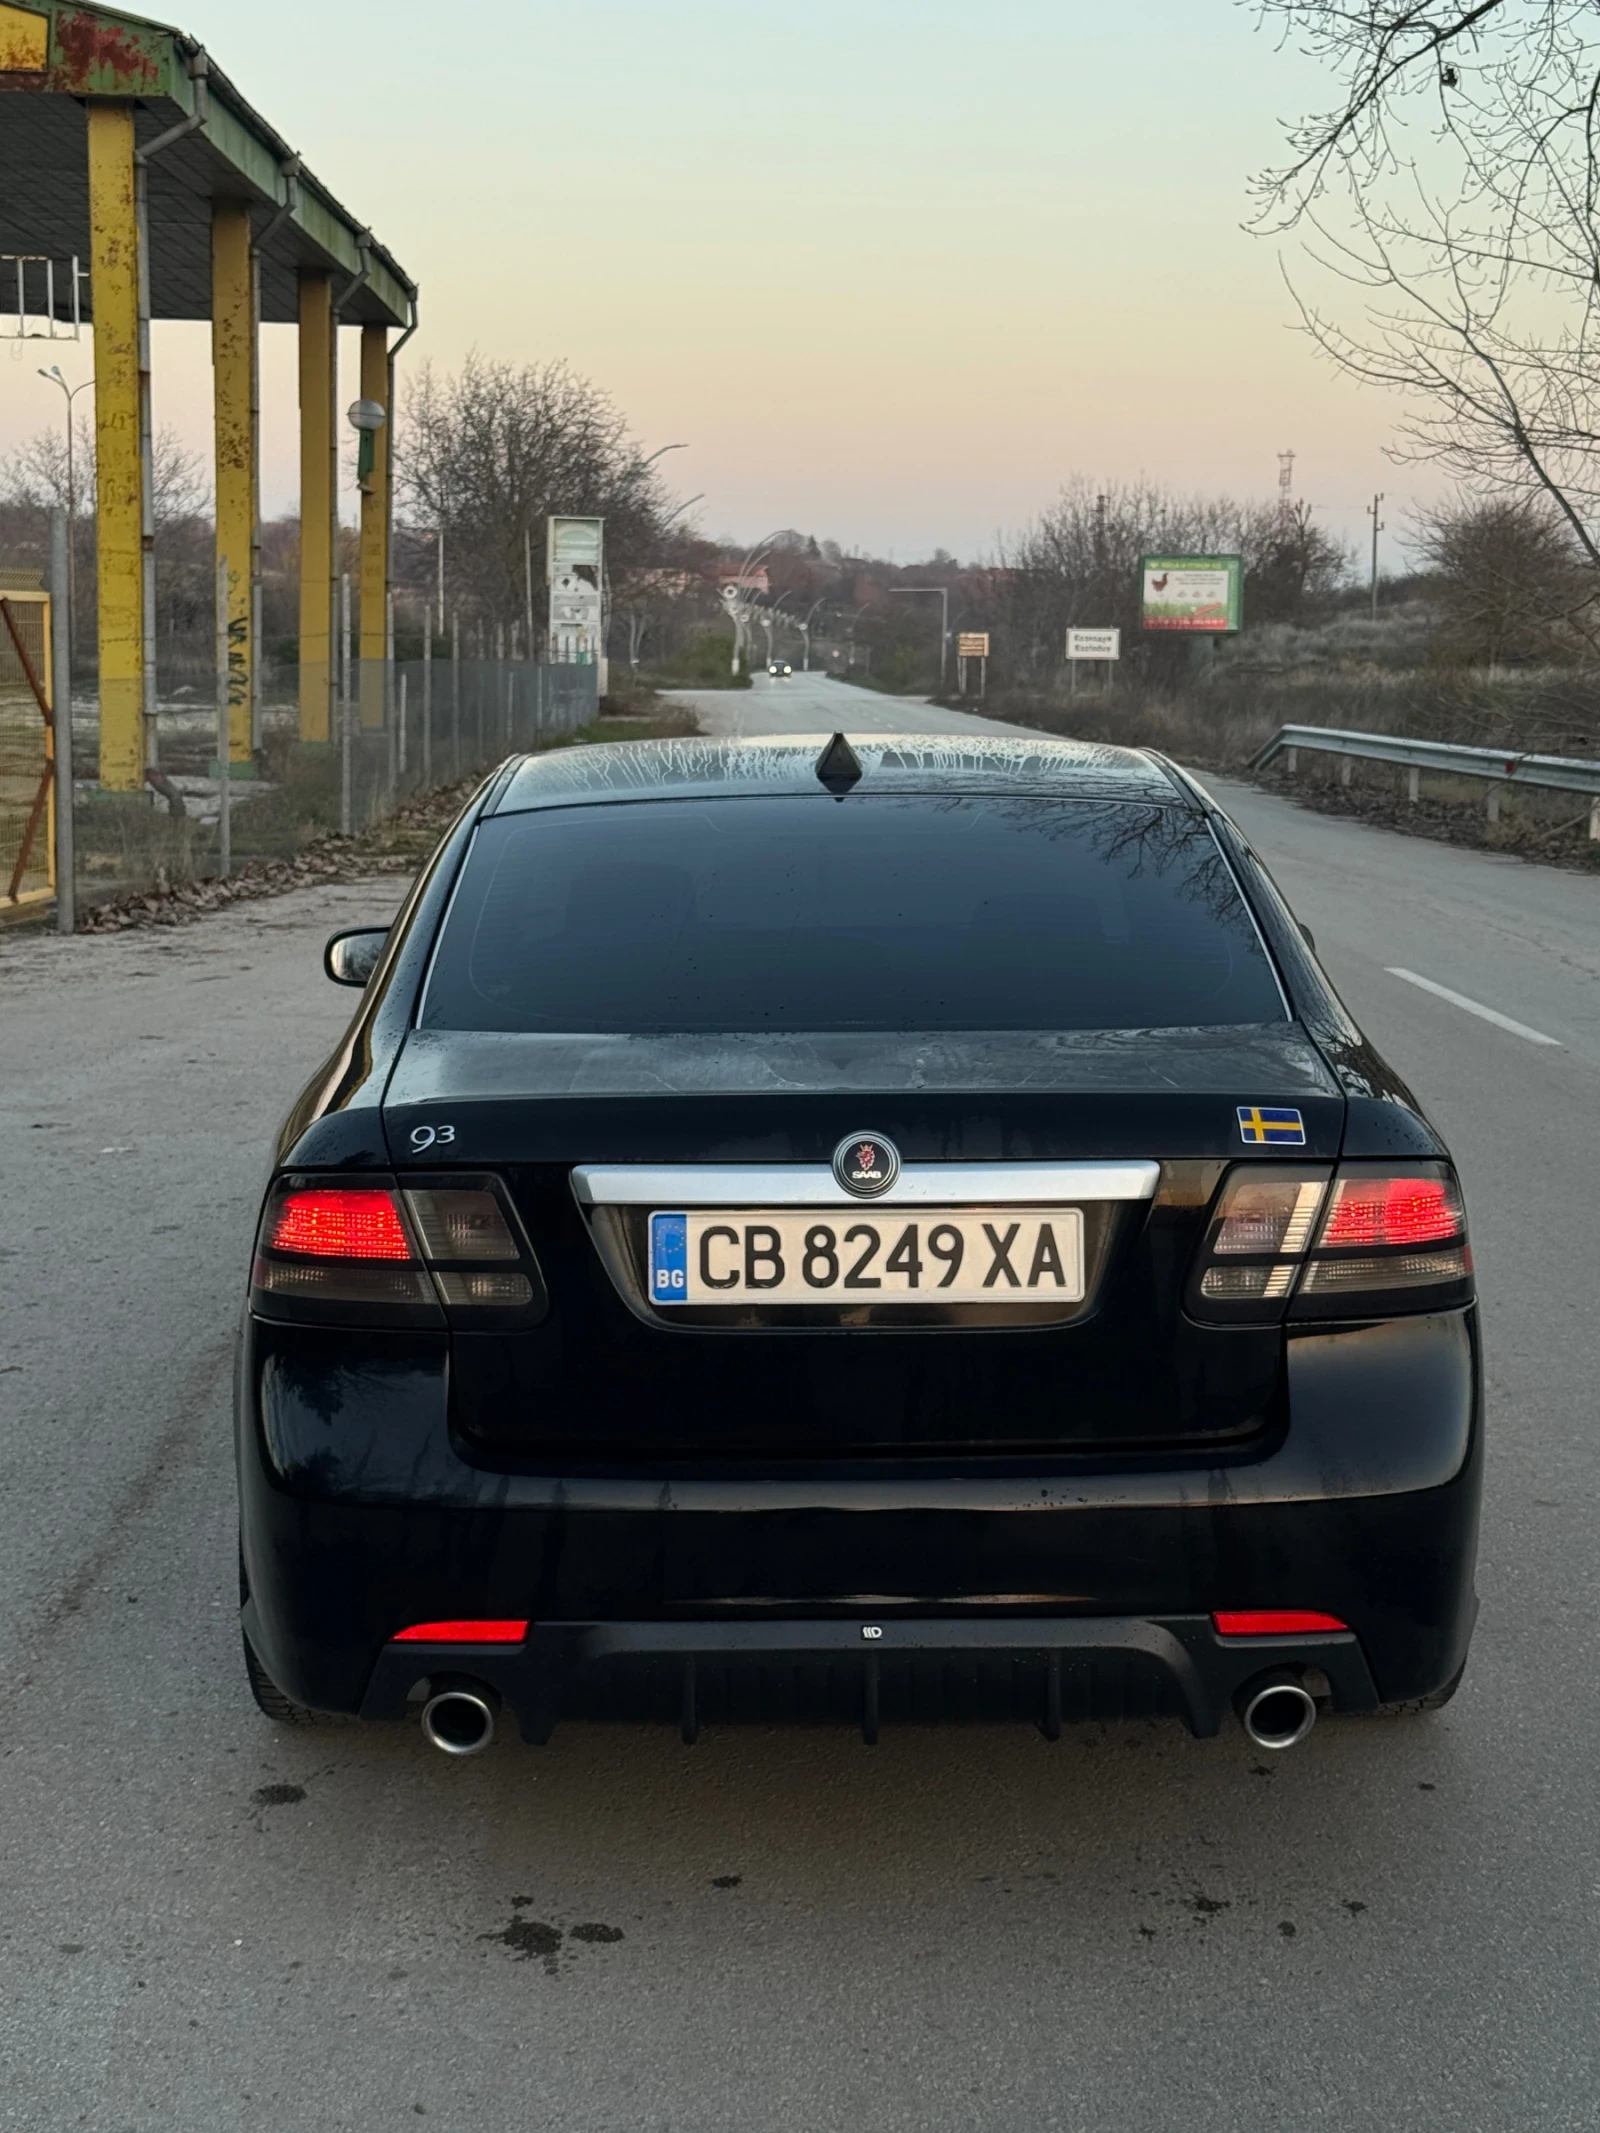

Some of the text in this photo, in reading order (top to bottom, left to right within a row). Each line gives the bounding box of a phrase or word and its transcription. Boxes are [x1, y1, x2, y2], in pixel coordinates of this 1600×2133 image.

[410, 1125, 456, 1153] 93
[852, 1170, 882, 1179] SAAB
[699, 1222, 1067, 1290] CB 8249 XA
[656, 1269, 684, 1288] BG
